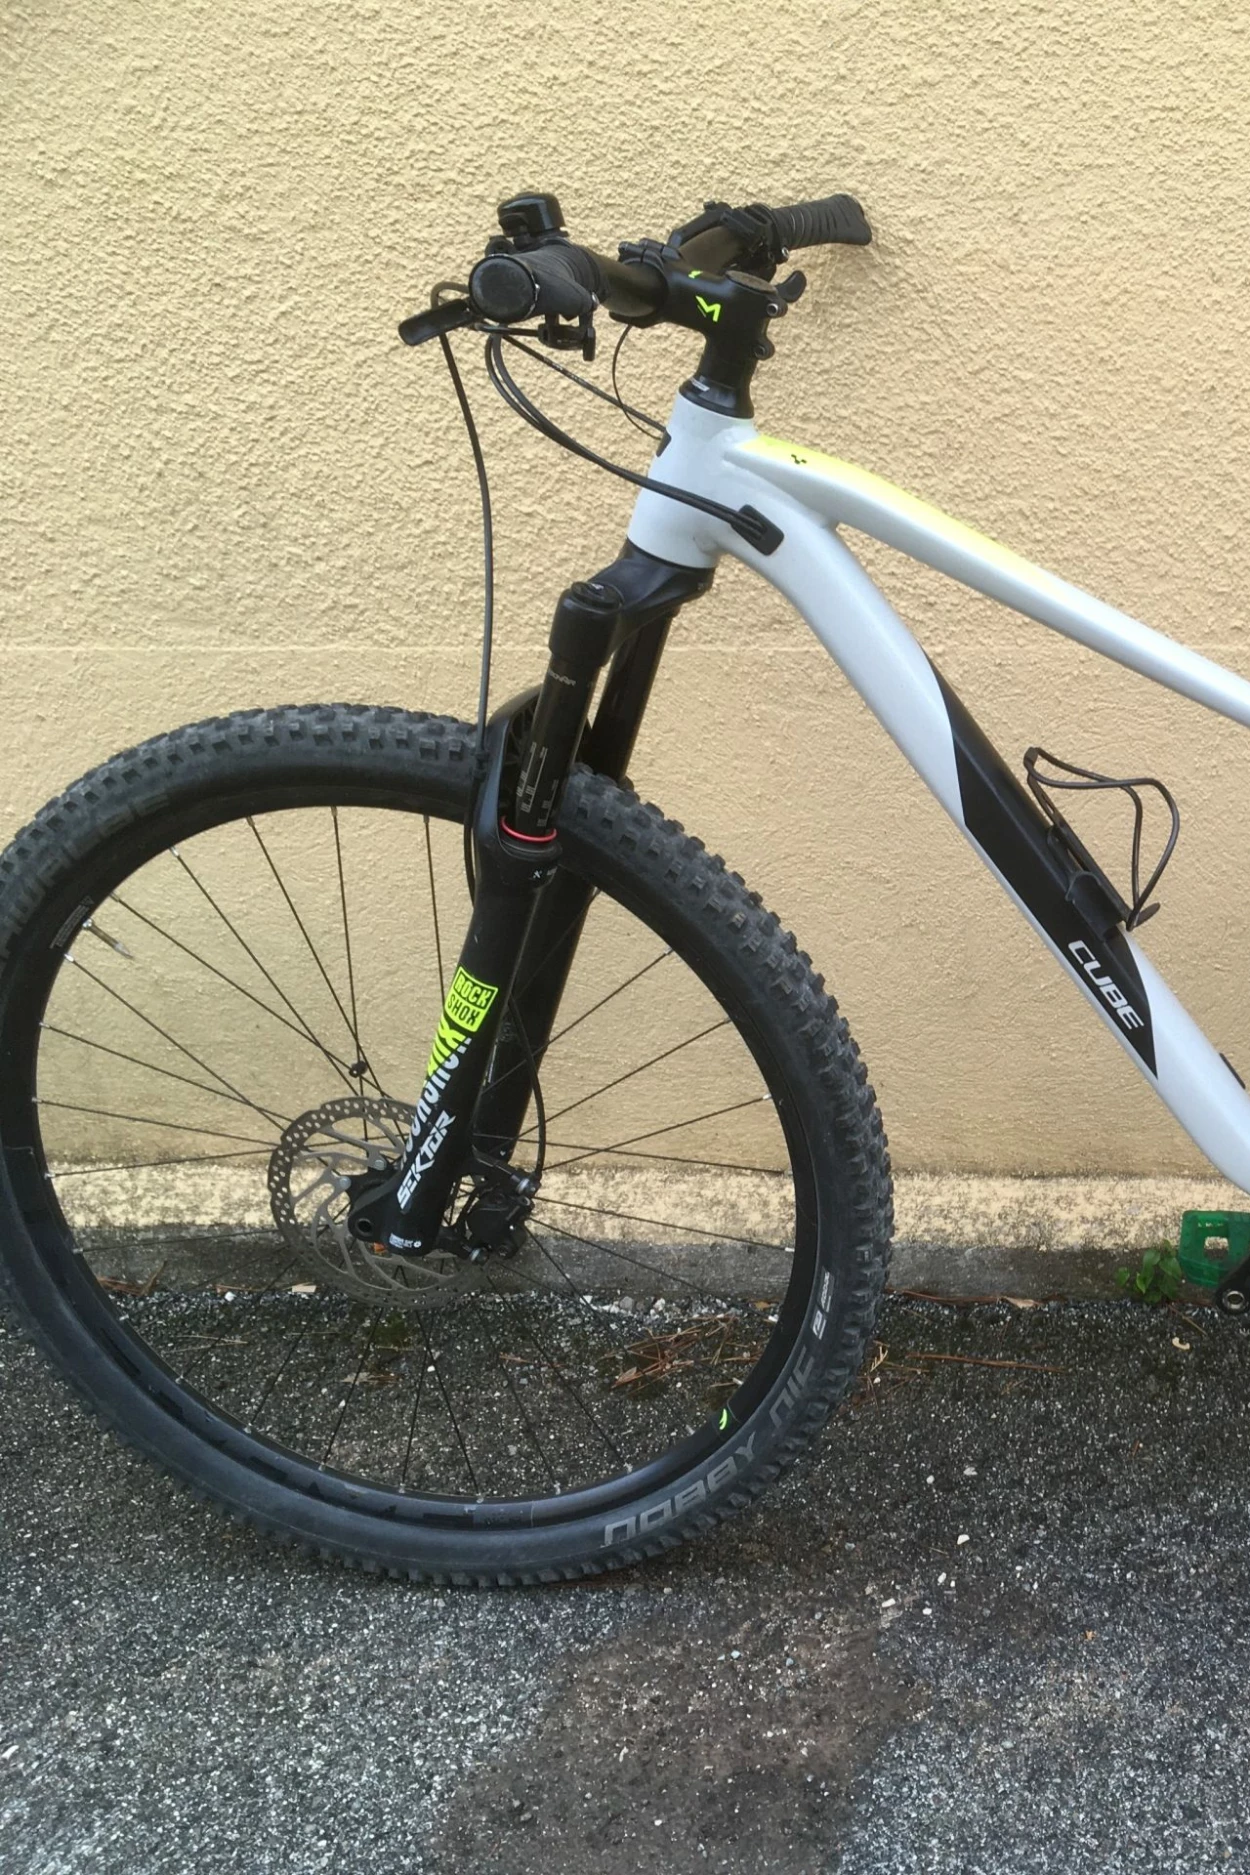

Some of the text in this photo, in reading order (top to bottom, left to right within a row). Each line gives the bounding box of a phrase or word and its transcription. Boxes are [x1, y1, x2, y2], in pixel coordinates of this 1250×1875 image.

[447, 994, 481, 1027] SHOX
[453, 973, 493, 1009] ROCK
[1068, 939, 1145, 1031] CUBE
[396, 1110, 457, 1210] SEKTOR
[601, 1345, 816, 1549] NOBBY NIC
